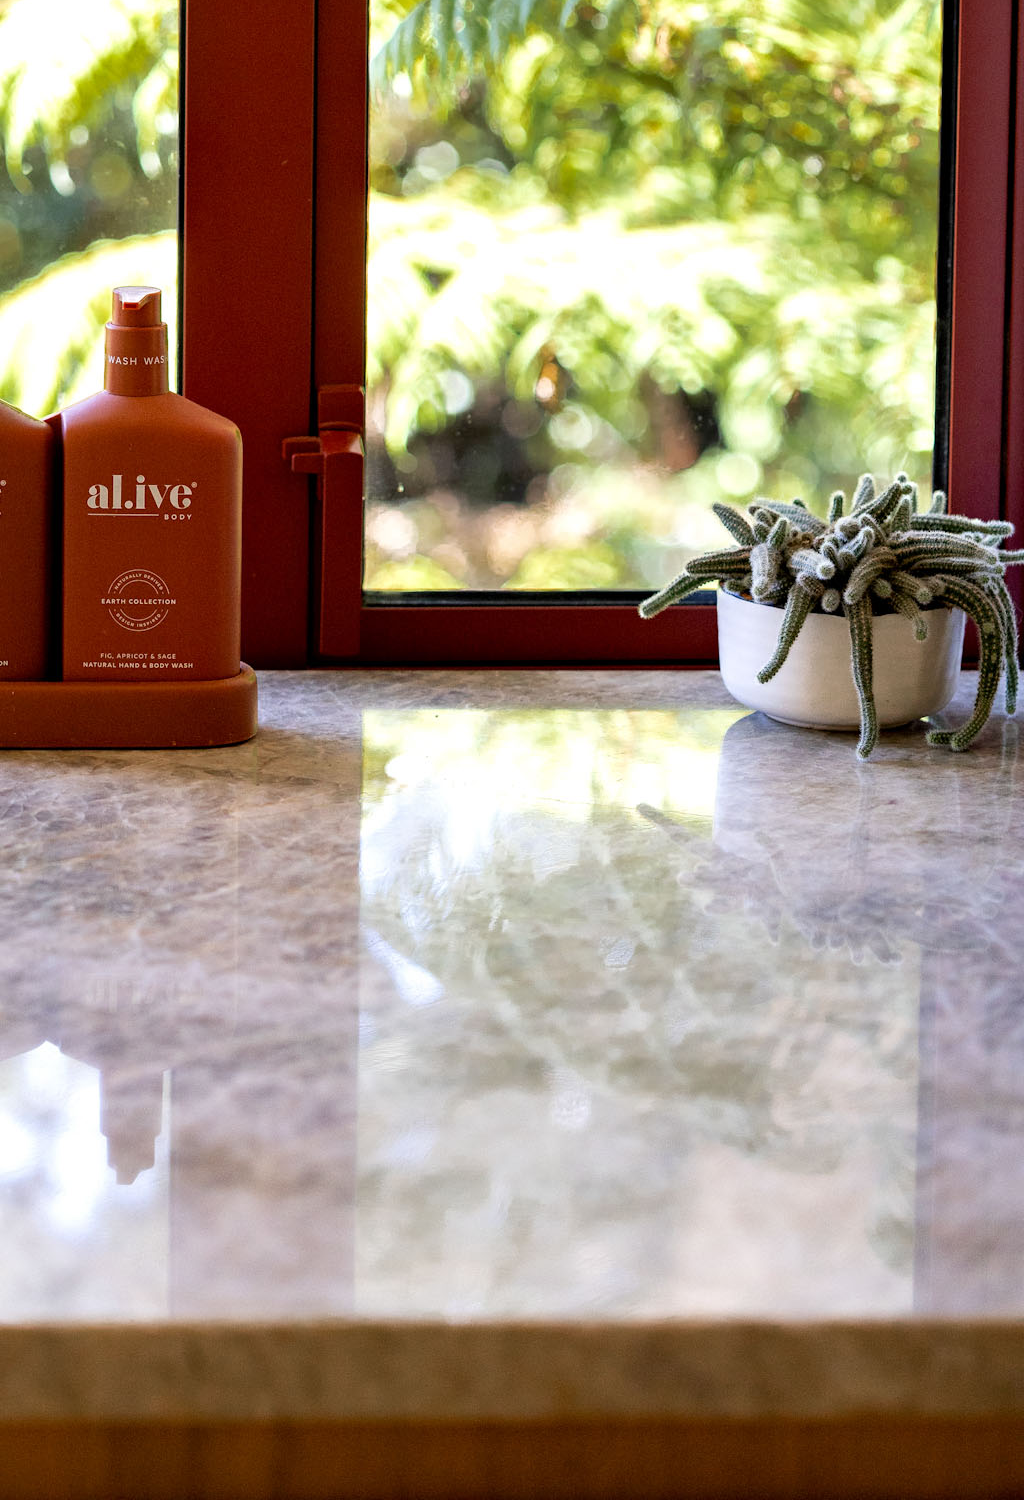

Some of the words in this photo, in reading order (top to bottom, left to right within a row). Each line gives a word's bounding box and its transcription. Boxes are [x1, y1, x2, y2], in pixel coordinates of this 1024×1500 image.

[108, 356, 137, 366] WASH
[144, 355, 167, 366] WAS
[164, 513, 192, 521] BODY
[114, 573, 142, 590] NATURALLY
[100, 652, 115, 660] FIG,
[82, 661, 117, 669] NATURAL
